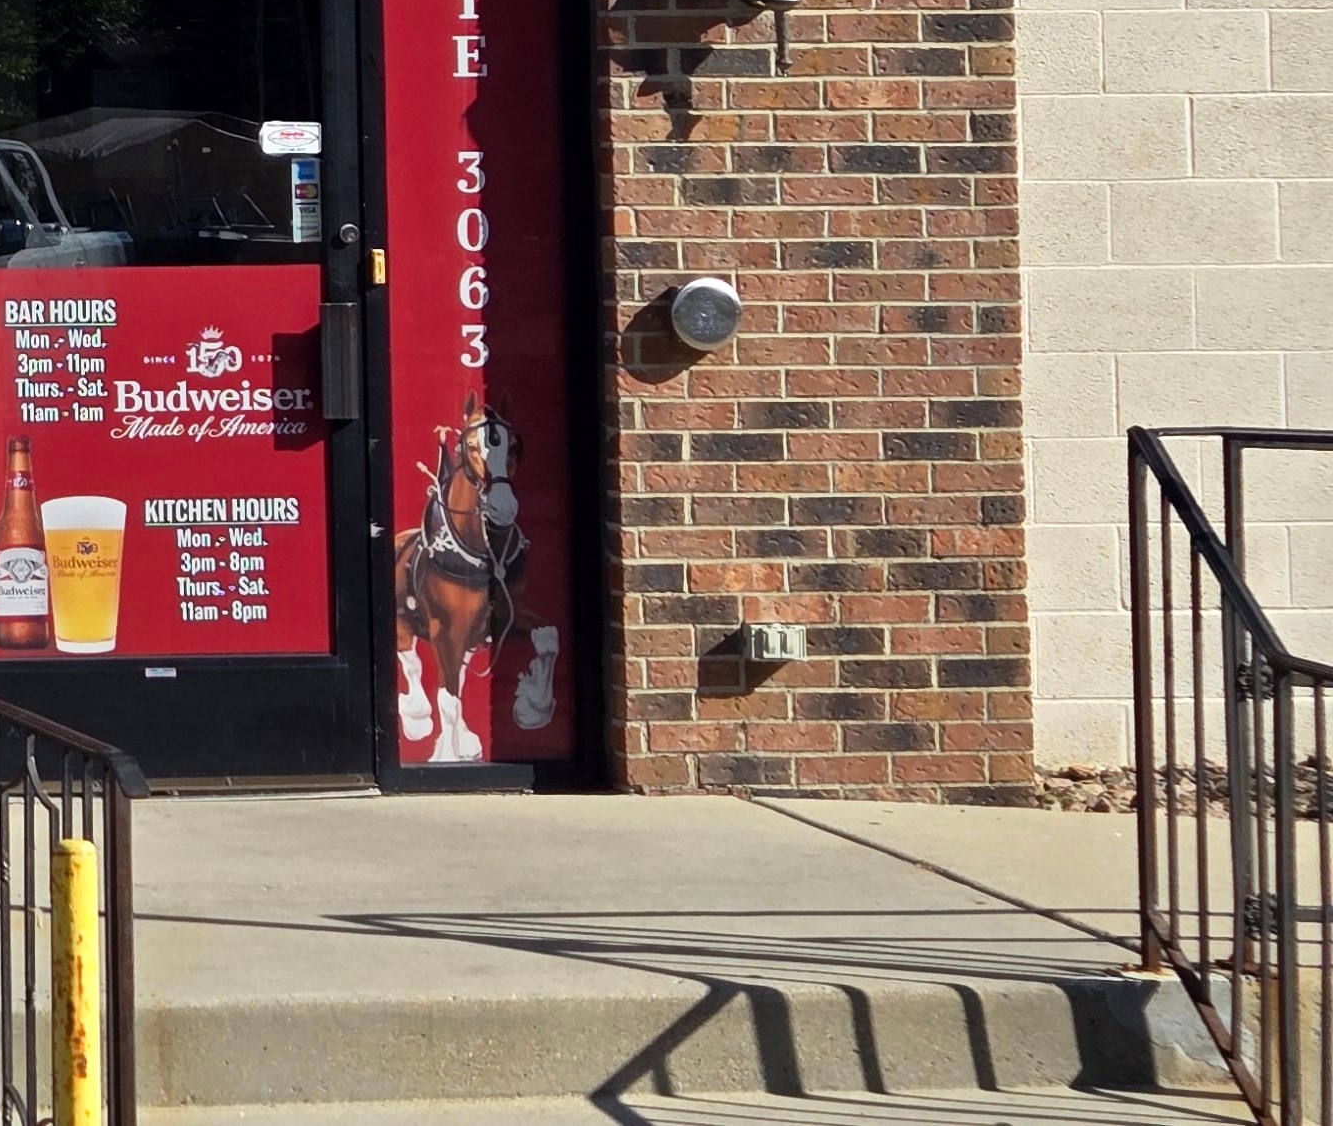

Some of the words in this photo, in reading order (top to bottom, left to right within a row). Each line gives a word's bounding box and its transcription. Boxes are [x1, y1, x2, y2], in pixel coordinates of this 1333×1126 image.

[456, 151, 489, 369] 3063
[5, 300, 44, 323] BAR
[50, 299, 116, 323] HOURS
[68, 328, 106, 348] Wed.
[18, 354, 53, 376] 3pm
[66, 354, 104, 375] 11pm
[15, 378, 64, 397] Thurs.
[78, 378, 108, 396] Sat.
[114, 380, 310, 413] Budweiser
[21, 403, 58, 421] 11am
[72, 403, 103, 421] 1am
[111, 415, 184, 439] Made
[188, 416, 215, 442] of
[208, 414, 308, 437] America
[145, 499, 226, 522] KITCHEN
[232, 498, 299, 522] HOURS
[229, 528, 268, 547] Wed.
[52, 555, 118, 569] Budweiser
[181, 553, 216, 575] 3pm
[230, 552, 264, 574] 8pm
[177, 577, 225, 596] Thurs.
[239, 576, 269, 595] Sat.
[180, 602, 218, 620] 11am
[232, 601, 267, 623] 8pm
